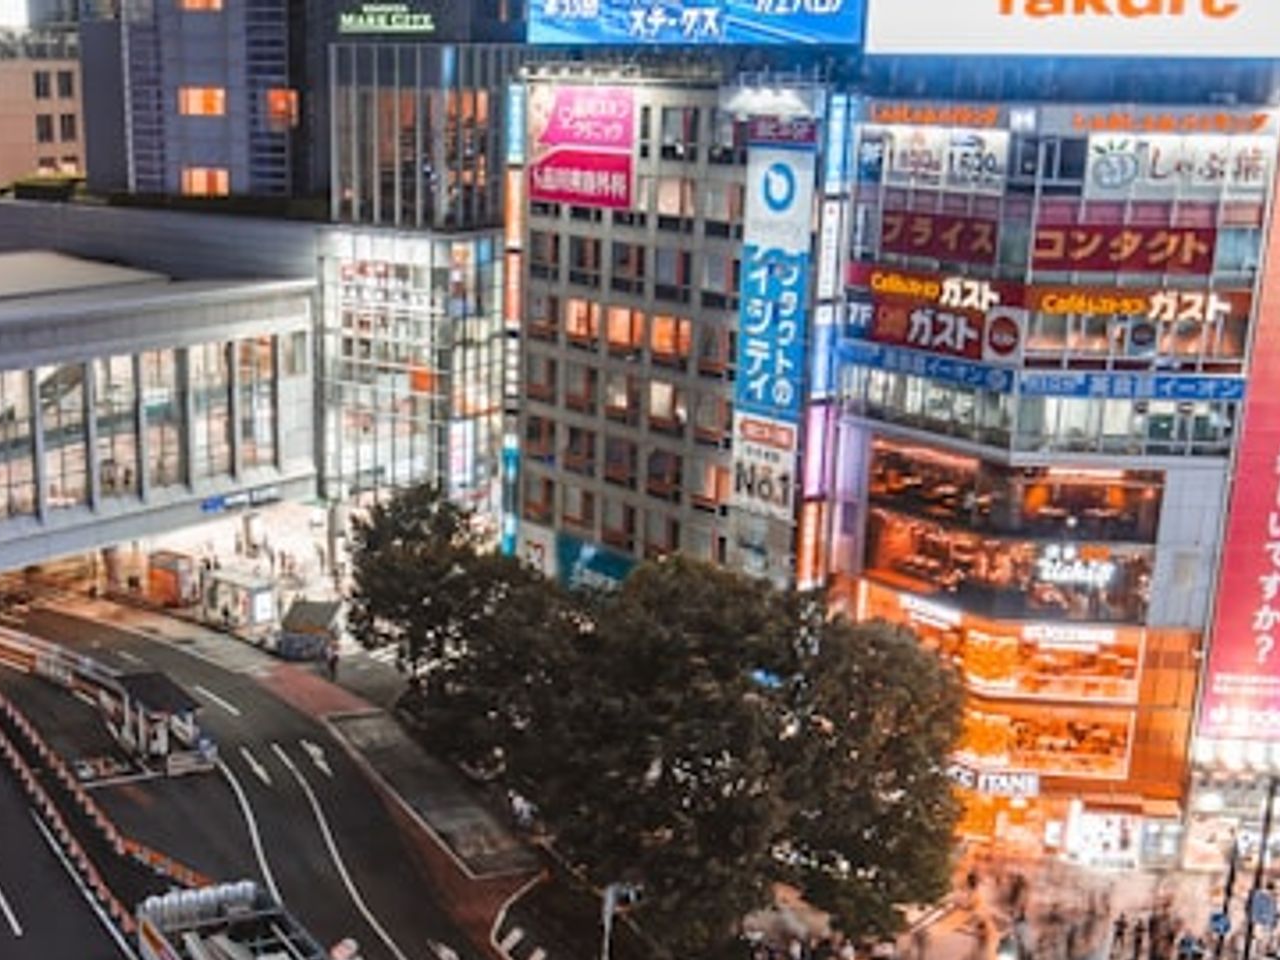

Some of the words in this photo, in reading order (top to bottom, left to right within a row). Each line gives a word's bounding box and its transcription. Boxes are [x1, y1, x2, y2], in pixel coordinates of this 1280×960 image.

[1034, 231, 1208, 263] コンタクト
